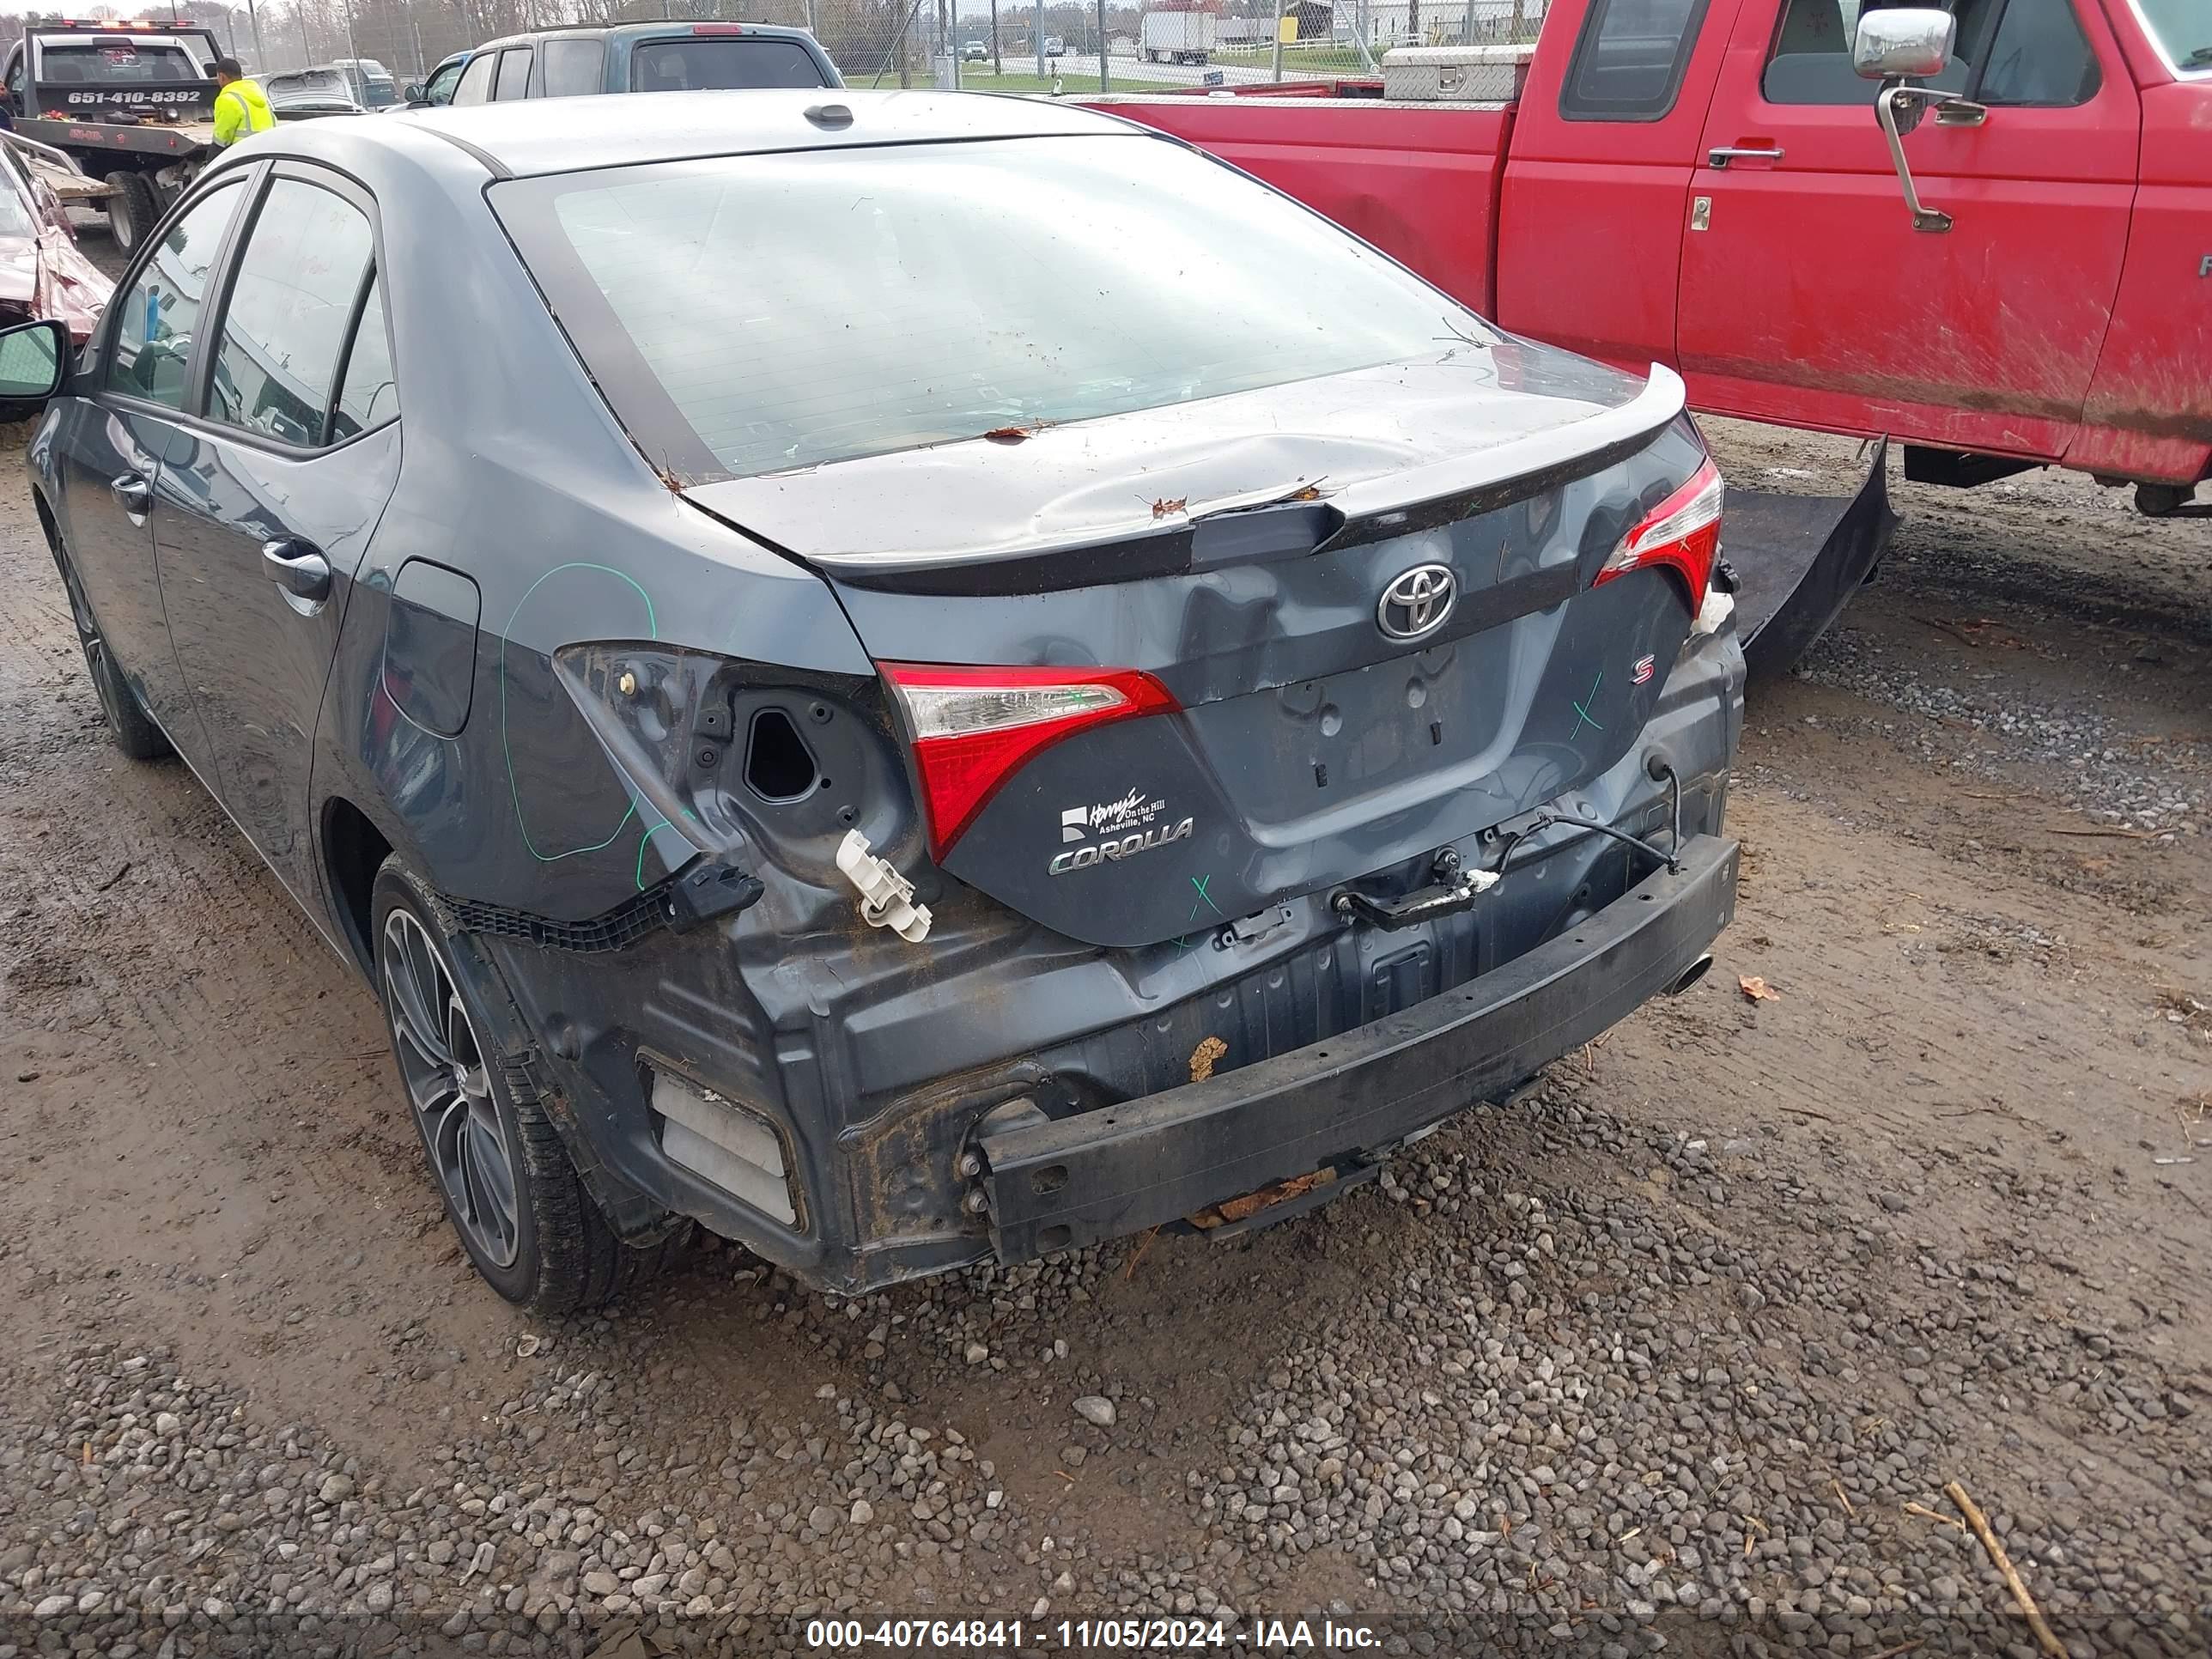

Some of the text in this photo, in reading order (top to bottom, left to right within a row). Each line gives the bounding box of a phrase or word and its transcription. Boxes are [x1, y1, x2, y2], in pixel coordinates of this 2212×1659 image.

[68, 91, 200, 104] 651-410-8392
[1630, 653, 1655, 685] S
[1125, 799, 1165, 819] On the Hill
[1099, 812, 1155, 835] Asheville, NC
[1048, 817, 1194, 876] COROLLA
